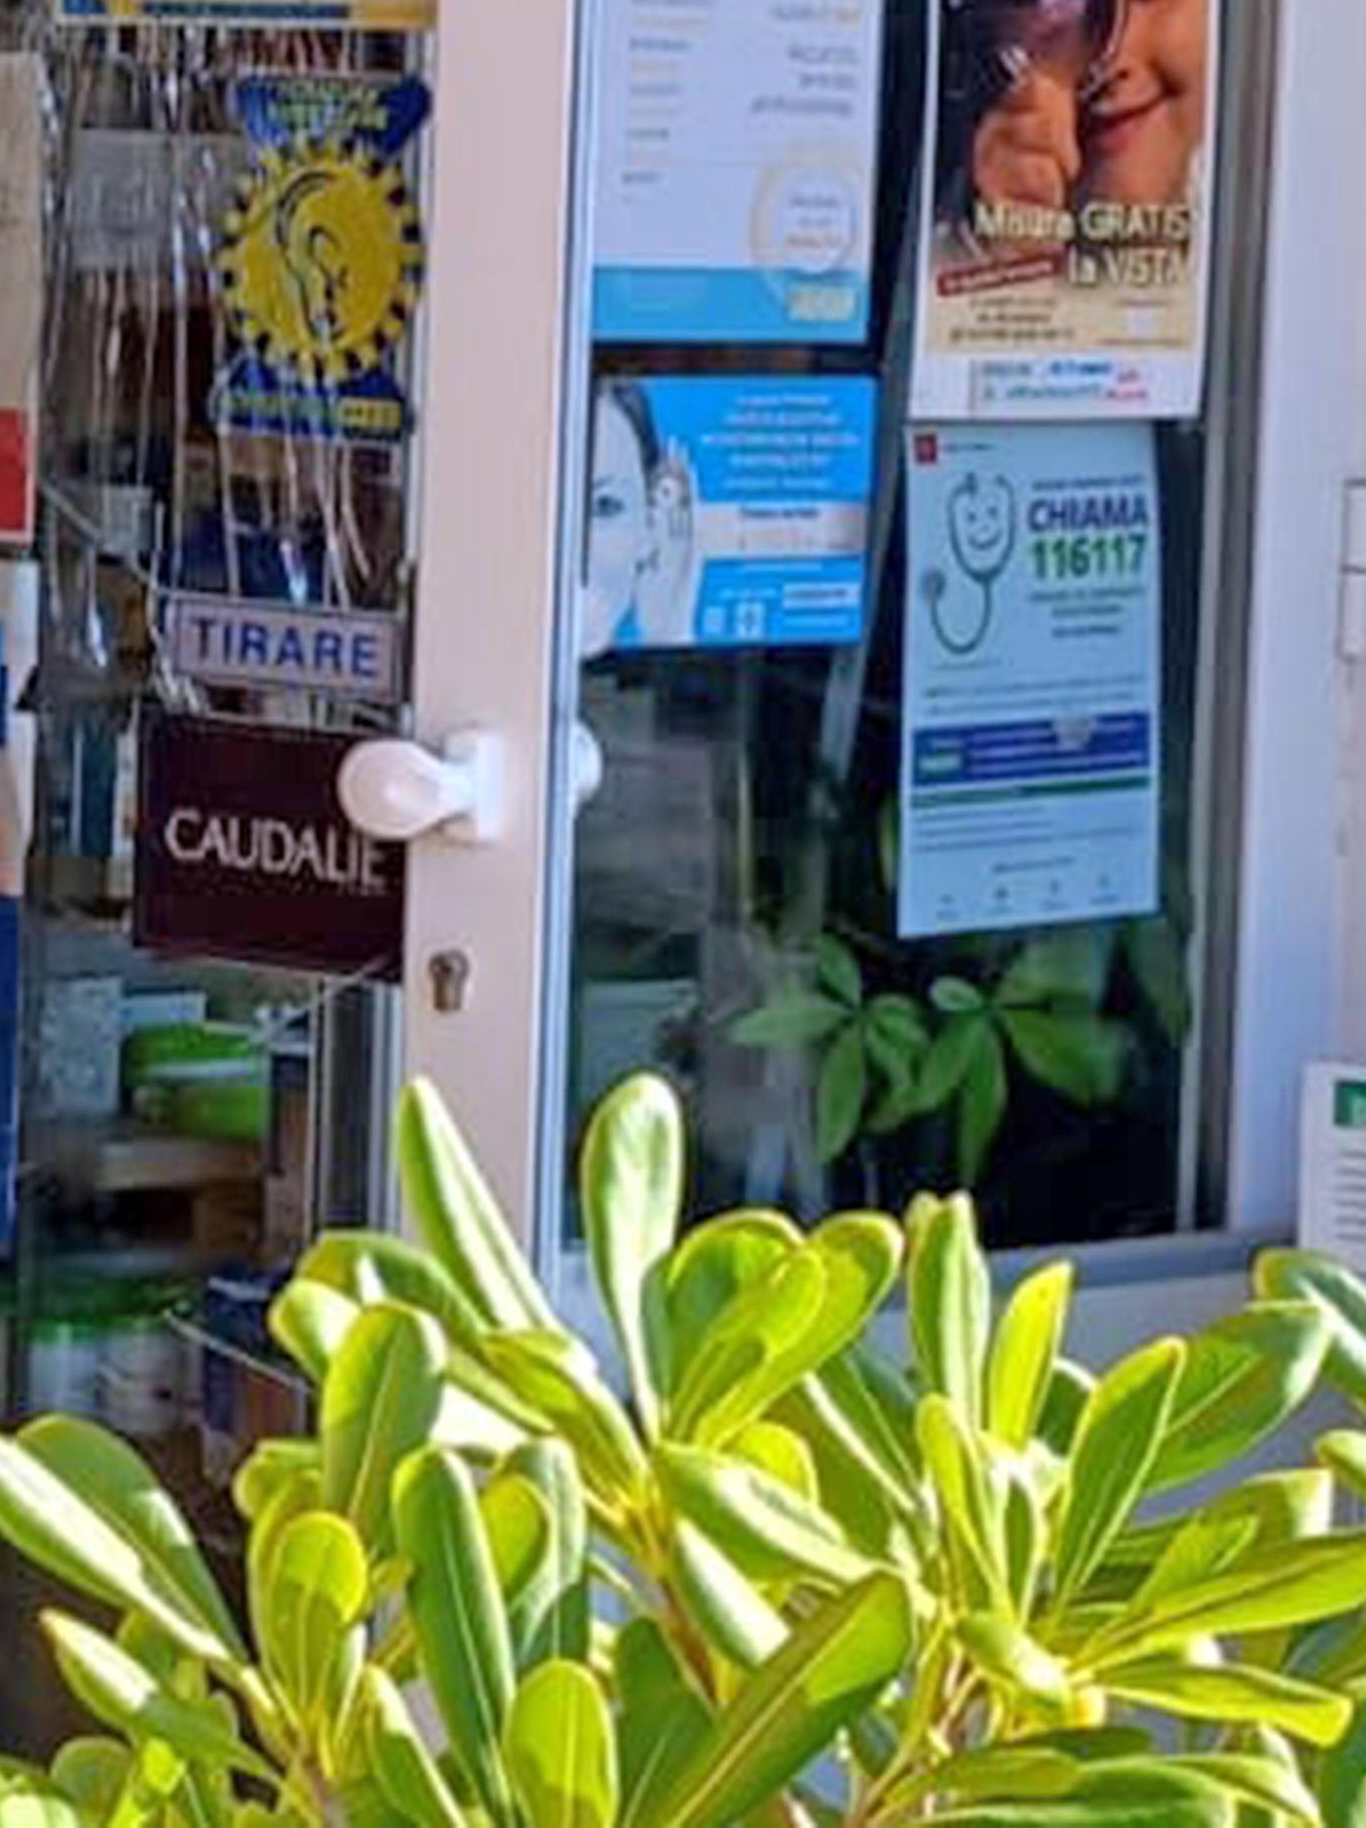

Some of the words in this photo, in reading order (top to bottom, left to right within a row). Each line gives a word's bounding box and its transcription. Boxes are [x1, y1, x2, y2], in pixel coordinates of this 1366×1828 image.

[1029, 493, 1149, 534] CHIAMA
[1031, 533, 1147, 580] 116117
[189, 617, 381, 678] TIRARE
[164, 807, 387, 893] CAUDALIE
